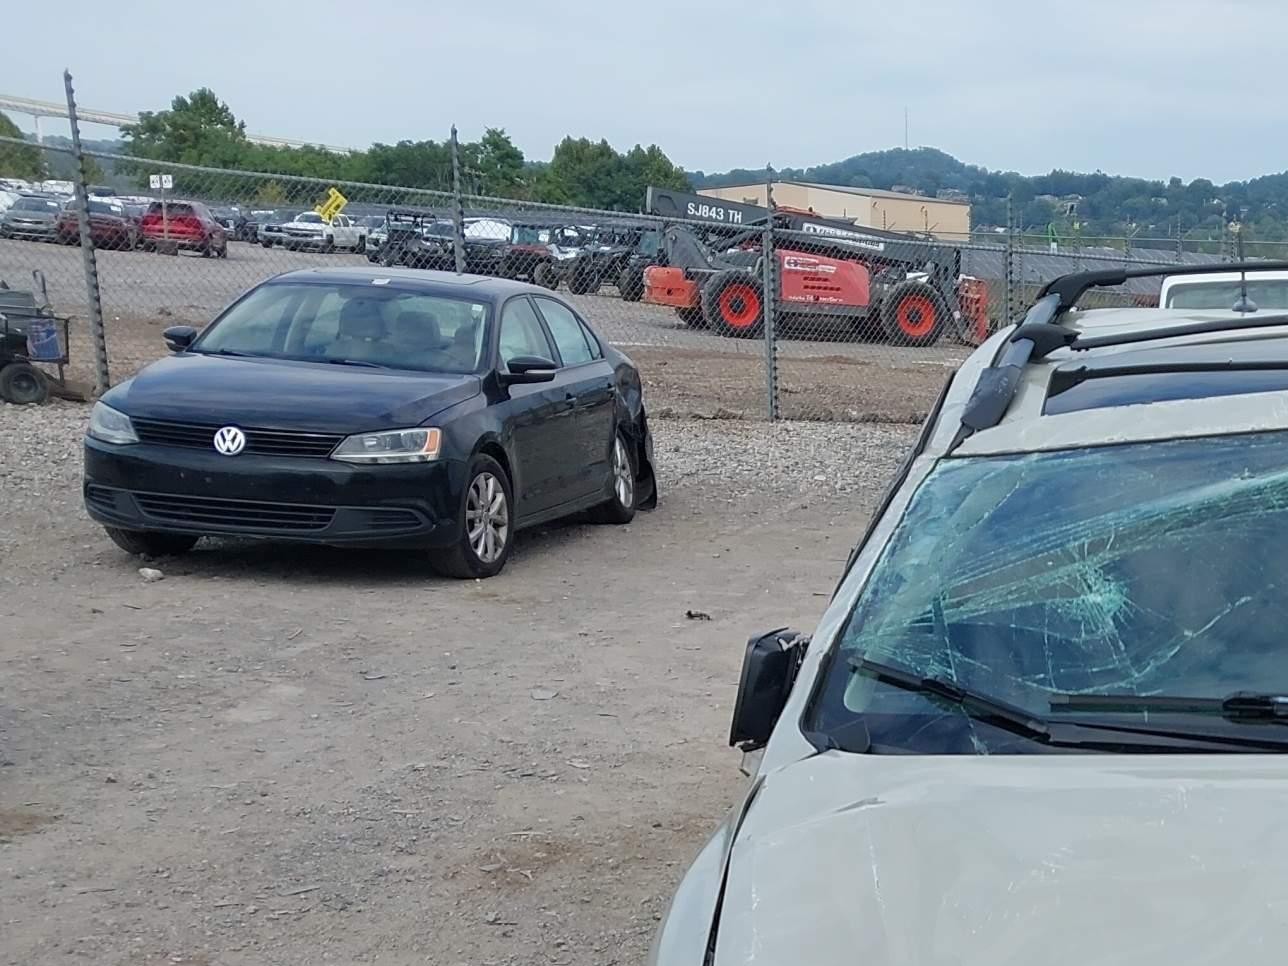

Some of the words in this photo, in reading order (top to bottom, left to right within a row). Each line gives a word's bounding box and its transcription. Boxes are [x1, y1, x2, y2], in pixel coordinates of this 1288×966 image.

[687, 202, 724, 220] SJ843
[728, 209, 743, 224] TH
[215, 427, 244, 455] VW
